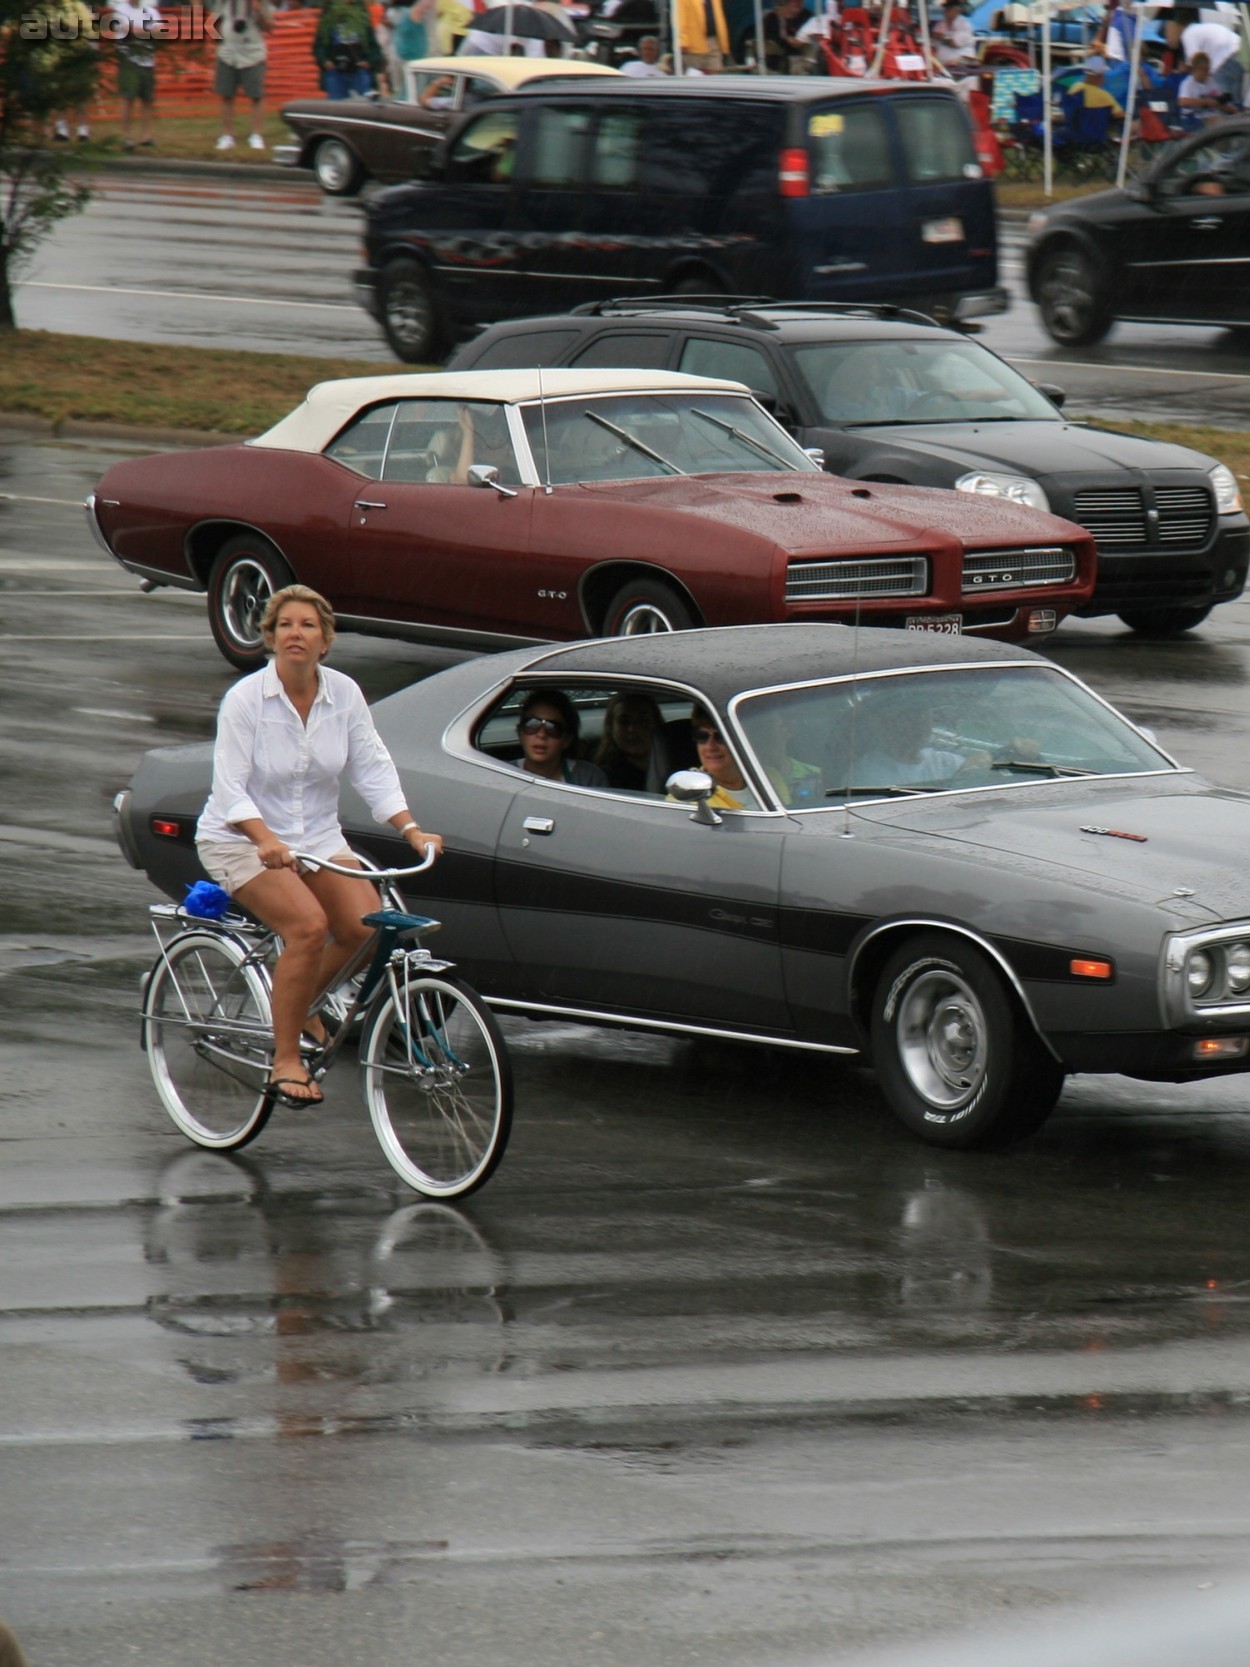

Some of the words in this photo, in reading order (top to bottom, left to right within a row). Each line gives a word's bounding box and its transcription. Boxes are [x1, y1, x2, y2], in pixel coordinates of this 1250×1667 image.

[973, 574, 1013, 584] GTO
[537, 589, 567, 599] GTO
[1080, 825, 1110, 834] 400
